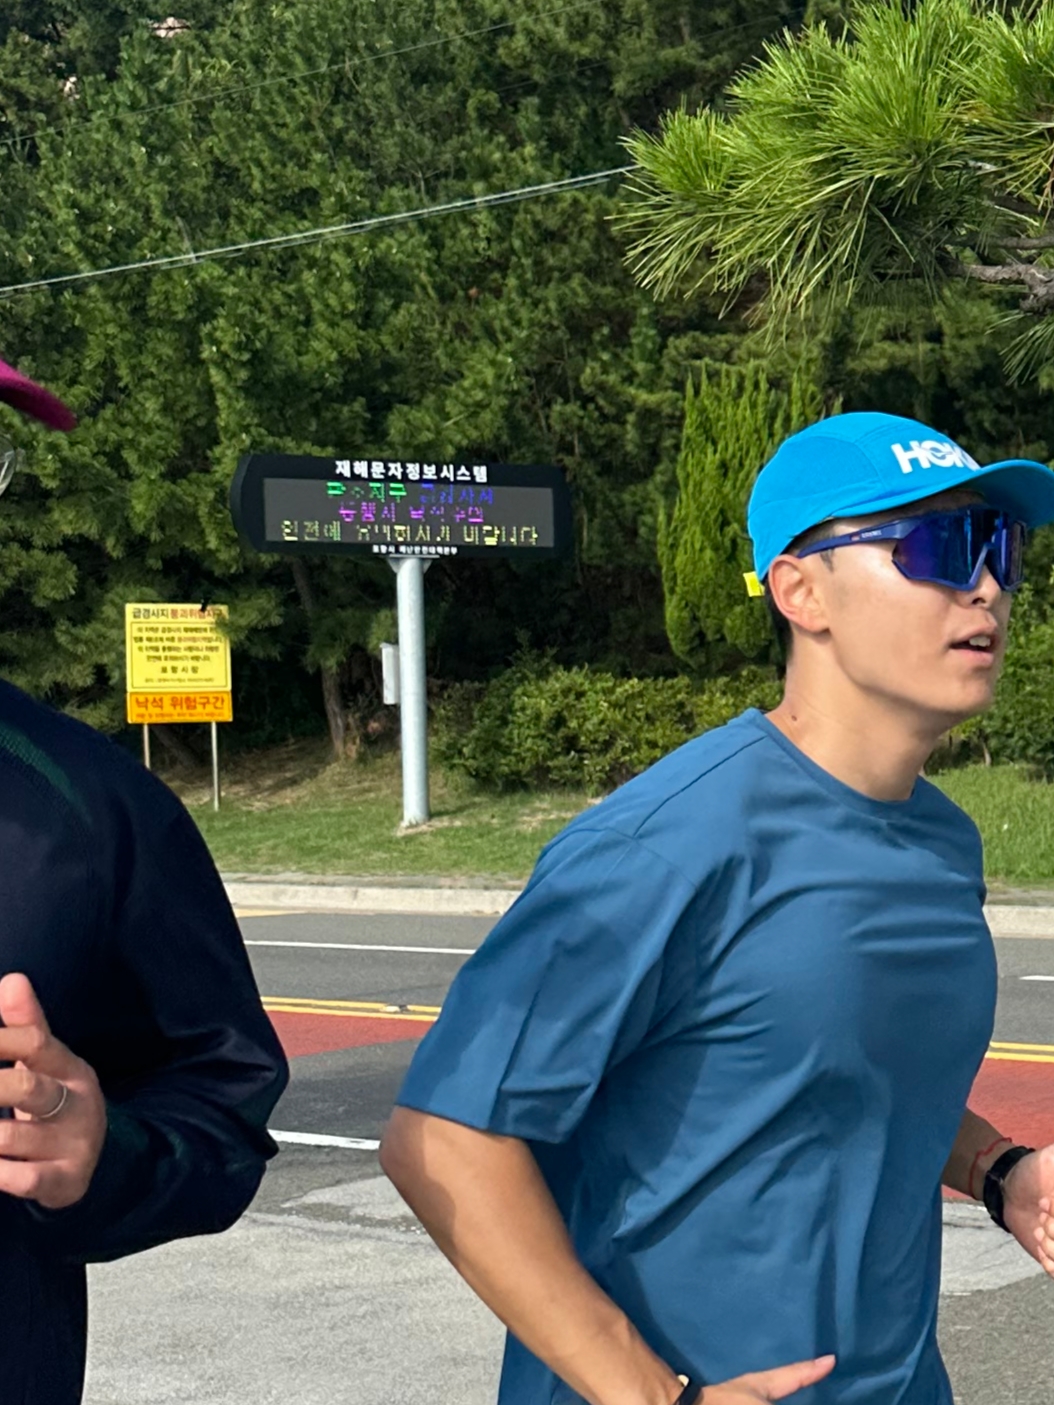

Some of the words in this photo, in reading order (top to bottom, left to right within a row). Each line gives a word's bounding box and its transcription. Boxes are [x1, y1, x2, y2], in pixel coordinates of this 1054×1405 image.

[335, 460, 488, 483] 재해문자정보시스템
[135, 696, 164, 712] 낙석
[170, 695, 225, 711] 위험구간
